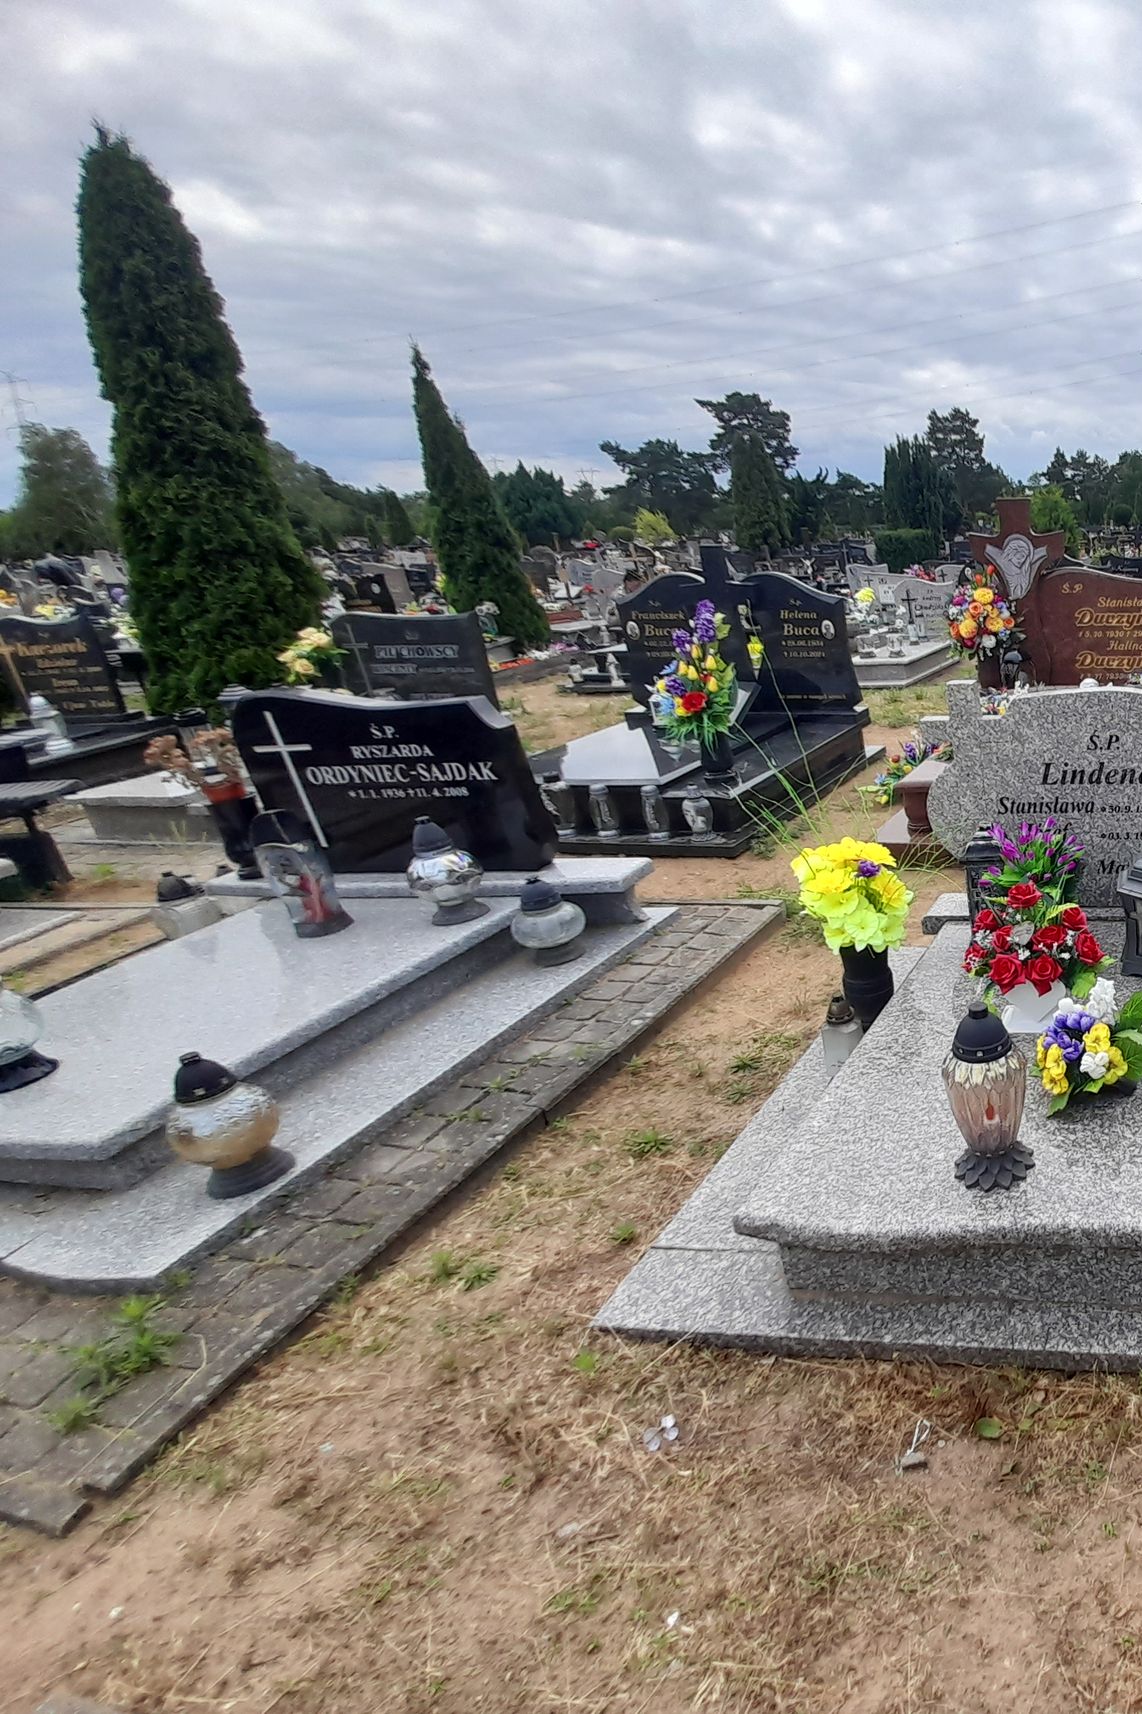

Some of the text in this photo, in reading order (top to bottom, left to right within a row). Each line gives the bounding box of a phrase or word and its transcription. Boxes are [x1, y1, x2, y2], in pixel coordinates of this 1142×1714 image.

[780, 610, 817, 620] Helena
[783, 623, 820, 636] Buca
[1087, 730, 1120, 751] Ś.P.
[350, 744, 434, 759] RYSZARDA
[305, 762, 498, 785] ORDYNIEC-SAJDAK
[998, 797, 1095, 814] Stanisława
